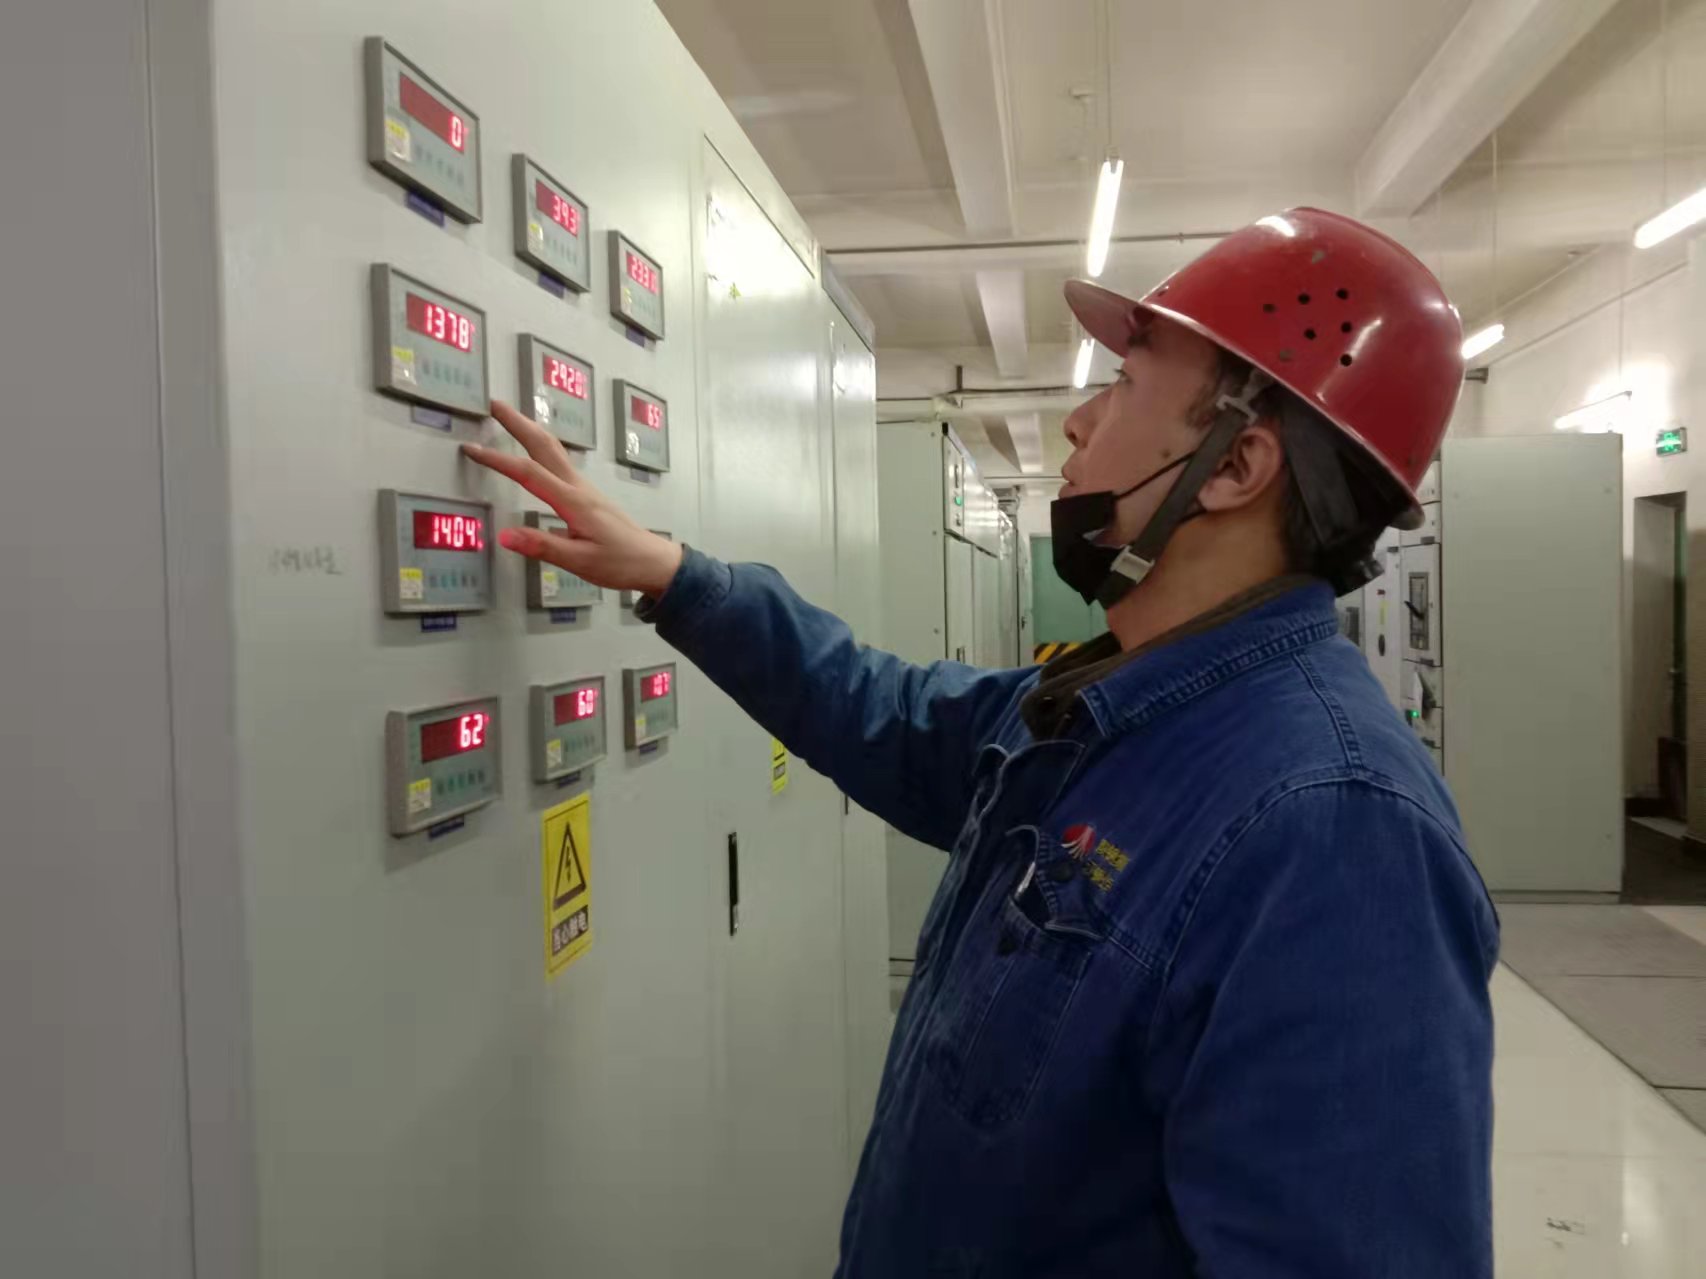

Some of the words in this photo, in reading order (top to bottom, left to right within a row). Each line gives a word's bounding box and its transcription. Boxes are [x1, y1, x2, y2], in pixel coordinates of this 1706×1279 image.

[451, 116, 462, 148] 0
[426, 304, 470, 349] 1378
[433, 515, 476, 548] 1404
[460, 713, 484, 748] 62
